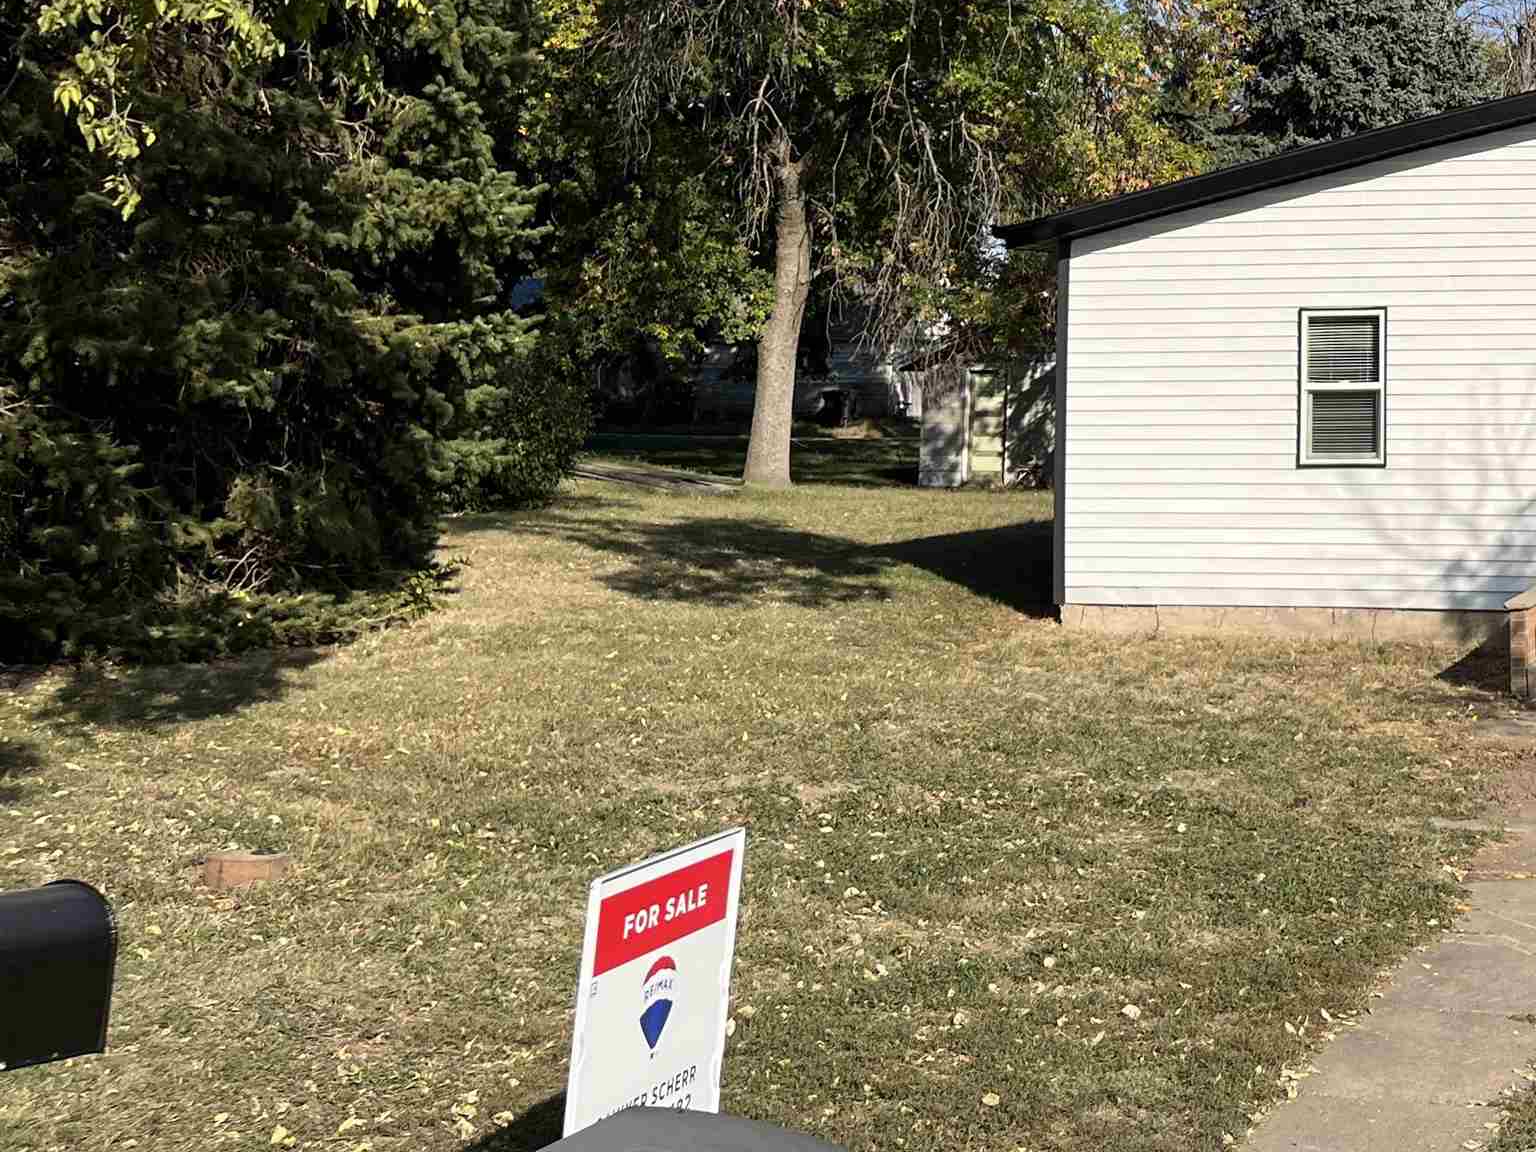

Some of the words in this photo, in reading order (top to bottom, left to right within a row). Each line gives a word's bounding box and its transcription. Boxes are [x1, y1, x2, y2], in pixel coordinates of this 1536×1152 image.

[623, 903, 660, 940] FOR
[664, 883, 709, 921] SALE
[651, 1065, 697, 1105] SCHERR
